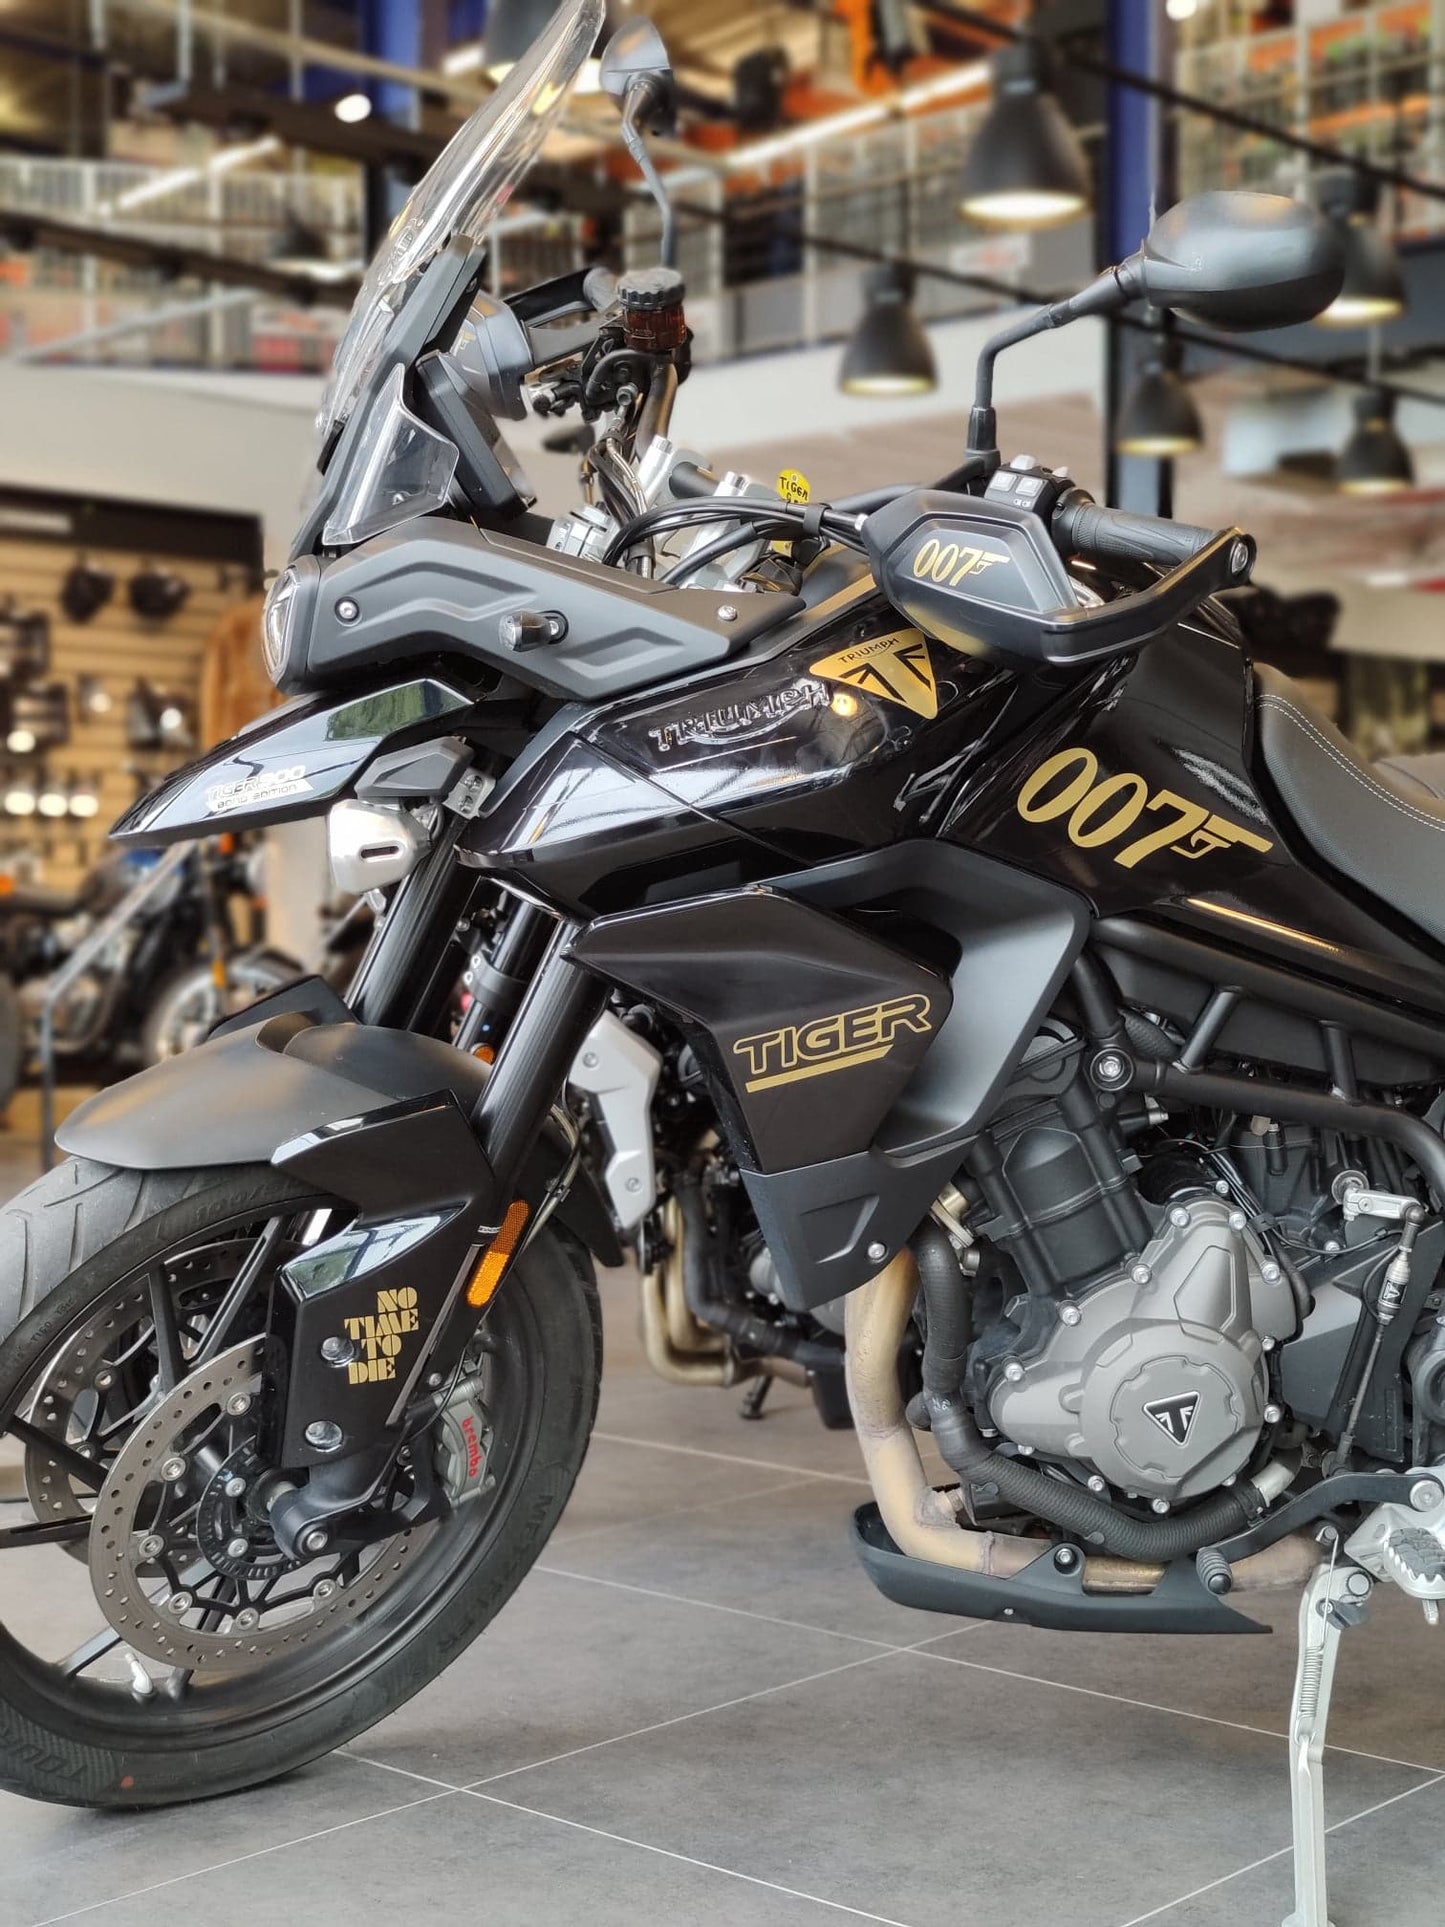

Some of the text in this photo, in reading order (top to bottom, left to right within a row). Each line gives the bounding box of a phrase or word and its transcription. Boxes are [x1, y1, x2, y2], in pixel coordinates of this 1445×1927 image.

[914, 539, 983, 586] 007
[837, 637, 900, 665] TRIUMPH
[649, 680, 832, 751] TRIUMPH
[1018, 748, 1209, 869] 007
[733, 993, 932, 1075] TIGER
[377, 1286, 418, 1313] NO
[344, 1310, 419, 1340] TIME
[361, 1334, 402, 1360] TO
[348, 1357, 396, 1385] DIE
[462, 1415, 482, 1478] brembo
